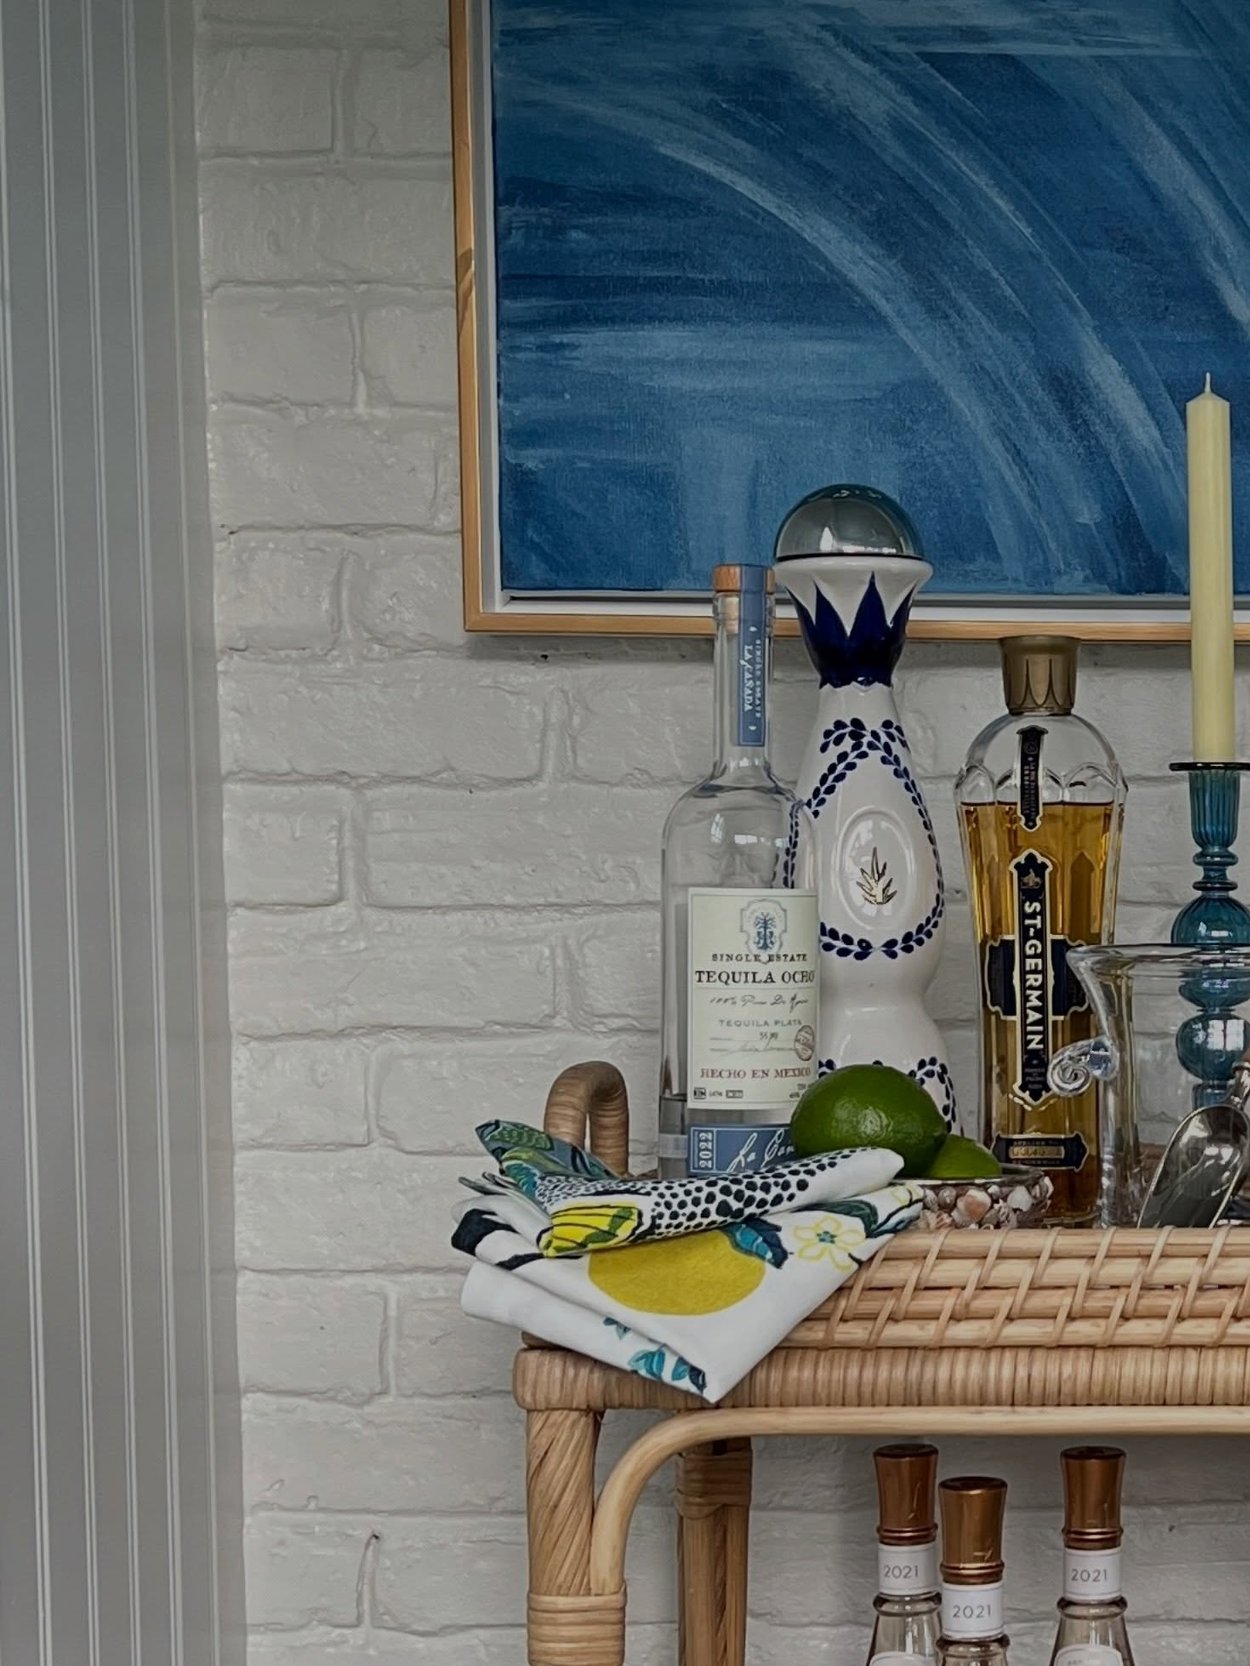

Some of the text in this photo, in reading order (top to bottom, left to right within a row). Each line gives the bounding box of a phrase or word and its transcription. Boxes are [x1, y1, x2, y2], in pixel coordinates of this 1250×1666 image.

[711, 953, 807, 962] SINGLE ESTATE
[695, 970, 776, 985] TEQUILA
[719, 1019, 769, 1028] TEQUILA
[700, 1067, 811, 1079] HECHO EN MEXICO
[699, 1131, 713, 1169] 2022
[883, 1564, 919, 1579] 2021
[1071, 1568, 1108, 1582] 2021
[952, 1604, 992, 1618] 2021
